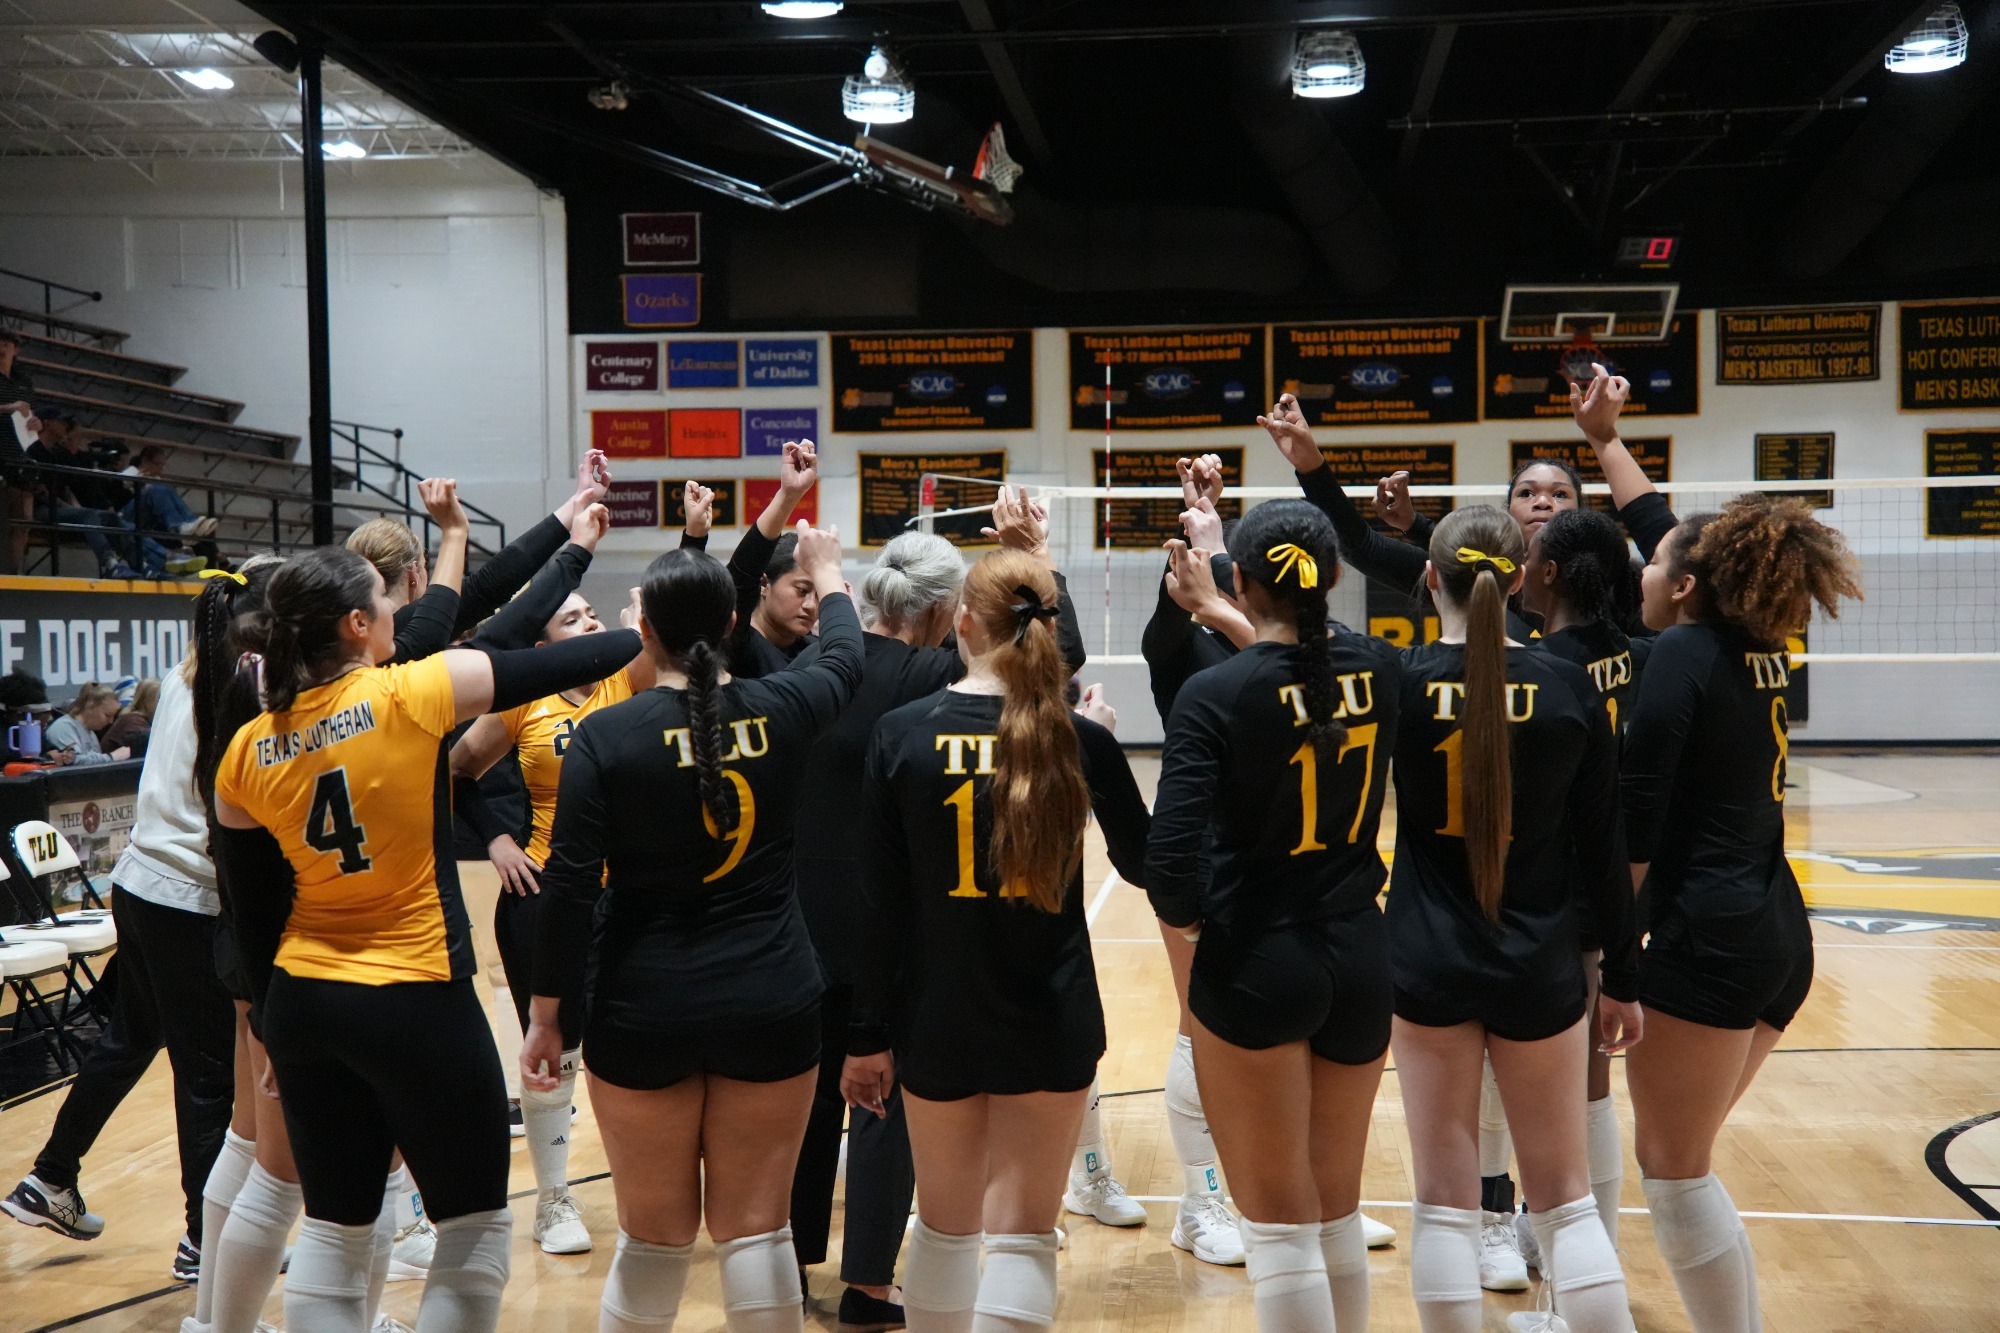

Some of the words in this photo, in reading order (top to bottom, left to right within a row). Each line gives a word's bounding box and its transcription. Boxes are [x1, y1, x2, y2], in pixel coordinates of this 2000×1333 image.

[633, 232, 688, 248] McMurry
[1647, 238, 1673, 259] 0
[635, 292, 689, 308] Ozarks
[1727, 316, 1757, 332] Texas
[1760, 315, 1811, 332] Lutheran
[1813, 312, 1871, 331] University
[1919, 317, 1964, 338] TEXAS
[1290, 330, 1328, 342] Texas
[1329, 328, 1389, 341] Lutheran
[1390, 327, 1460, 341] University
[749, 349, 813, 364] University
[1726, 344, 1745, 357] HOT
[1747, 342, 1810, 357] CONFERENCE
[1812, 340, 1870, 354] CO-CHAMPS
[591, 354, 653, 370] Centenary
[1907, 349, 1937, 370] HOT
[1940, 346, 2000, 369] CONFER
[752, 366, 767, 380] of
[769, 365, 810, 379] Dallas
[1724, 360, 1757, 379] MEN'S
[1758, 358, 1824, 378] BASKETBALL
[1826, 356, 1872, 375] 1997-98
[600, 372, 645, 387] College
[910, 376, 955, 392] SCAC
[1145, 374, 1191, 390] SCAC
[1352, 368, 1398, 385] SCAC
[1914, 379, 1957, 400] MEN'S
[610, 418, 649, 431] Austin
[750, 416, 812, 431] Concordia
[682, 425, 728, 440] Hendrix
[607, 436, 653, 451] College
[1532, 445, 1570, 459] Men's
[1362, 448, 1427, 462] Basketball
[39, 619, 121, 687] DOG
[1426, 681, 1539, 722] TU
[256, 731, 301, 768] TEXAS
[304, 700, 376, 753] LUTHERAN
[935, 734, 1000, 775] TL
[1289, 722, 1379, 856] 17
[61, 811, 82, 829] THE
[101, 804, 134, 823] RANCH
[303, 765, 374, 876] 4
[702, 769, 756, 884] 9
[28, 831, 59, 864] TLU
